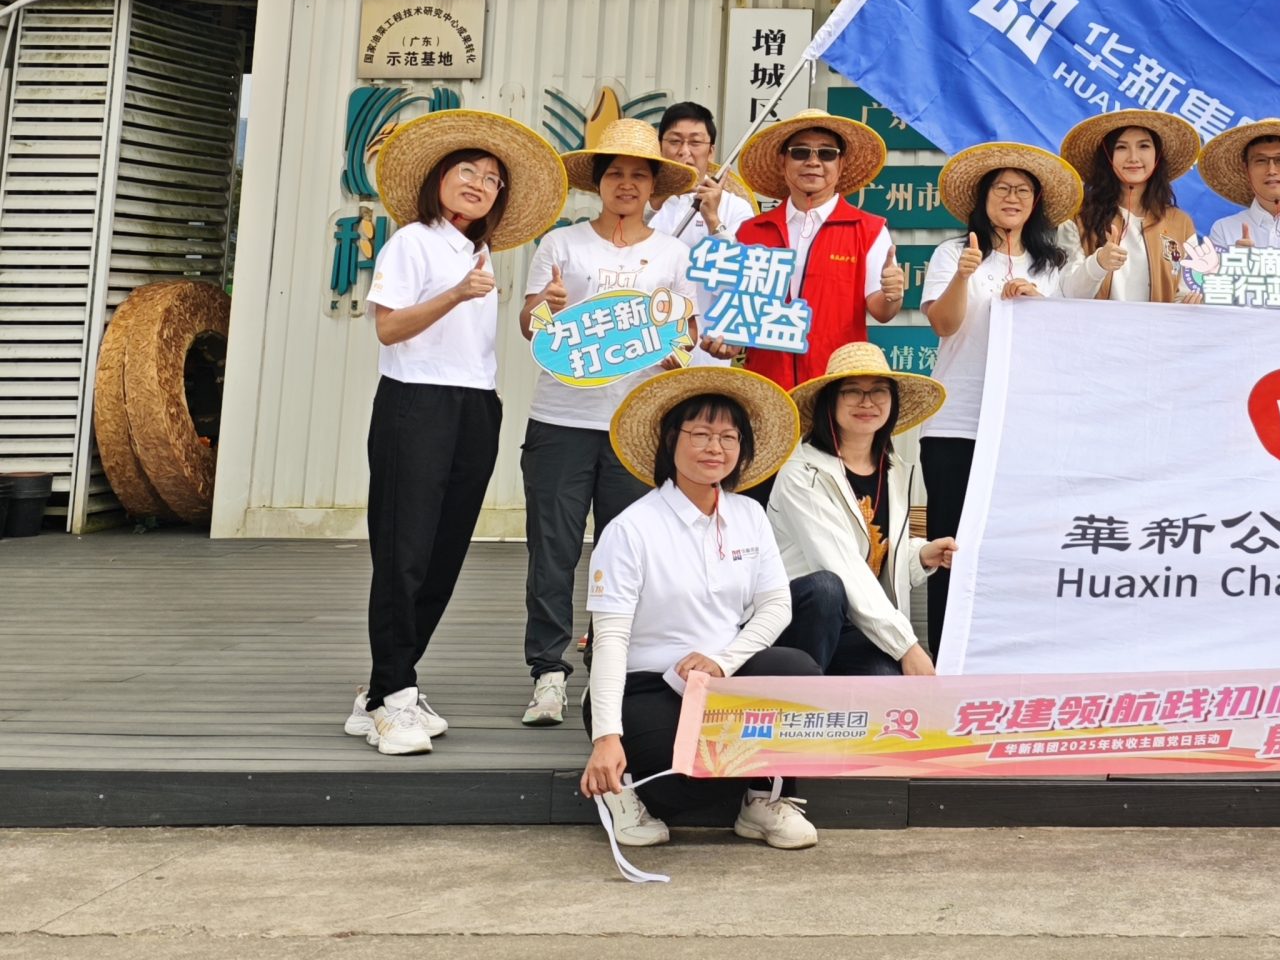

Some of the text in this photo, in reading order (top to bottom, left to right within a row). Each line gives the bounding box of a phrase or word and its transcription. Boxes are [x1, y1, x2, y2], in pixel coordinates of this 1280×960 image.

[363, 6, 477, 65] 国家油菜工程技术研究中心成果转化
[386, 51, 454, 67] 示范基地
[1073, 21, 1256, 144] 华新集
[688, 240, 794, 299] 华新
[546, 296, 648, 353] 为华新
[708, 292, 809, 351] 公益
[568, 327, 662, 379] 打call
[1056, 566, 1199, 599] Huaxin
[779, 729, 867, 739] HUAXIN GROUP
[781, 711, 869, 730] 华新集团
[1003, 732, 1221, 756] 华新集团2025年秋收主题党日活动
